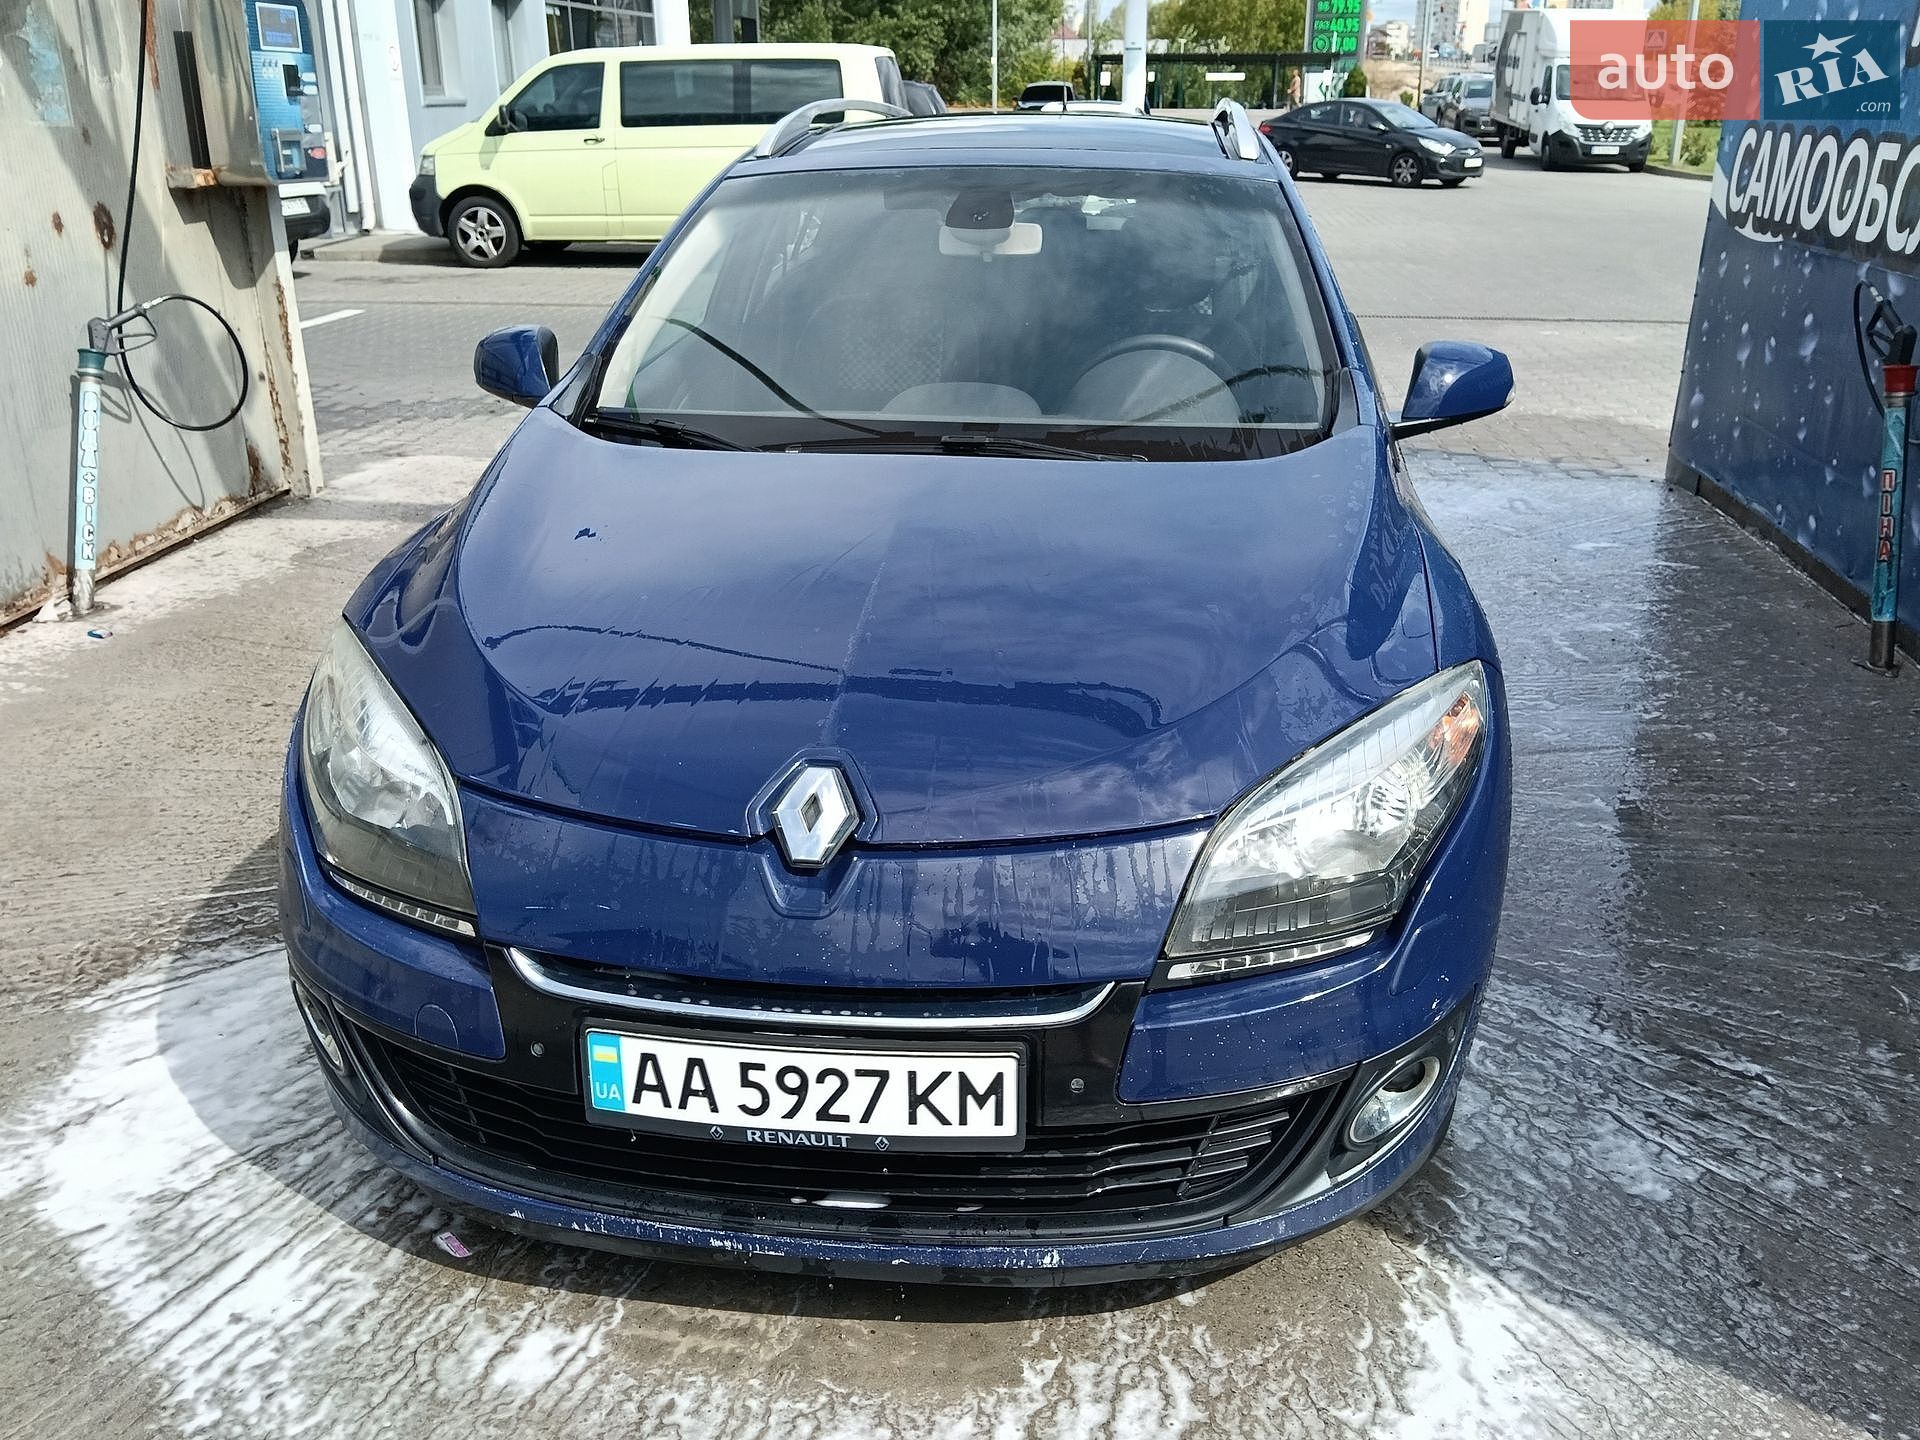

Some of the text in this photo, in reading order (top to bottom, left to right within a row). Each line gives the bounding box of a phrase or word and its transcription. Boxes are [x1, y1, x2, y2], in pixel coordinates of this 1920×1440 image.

[1878, 468, 1896, 562] ПІНА
[595, 1081, 622, 1101] UA
[632, 1052, 1004, 1126] AA 5927 KM
[746, 1128, 851, 1148] RENAULT
